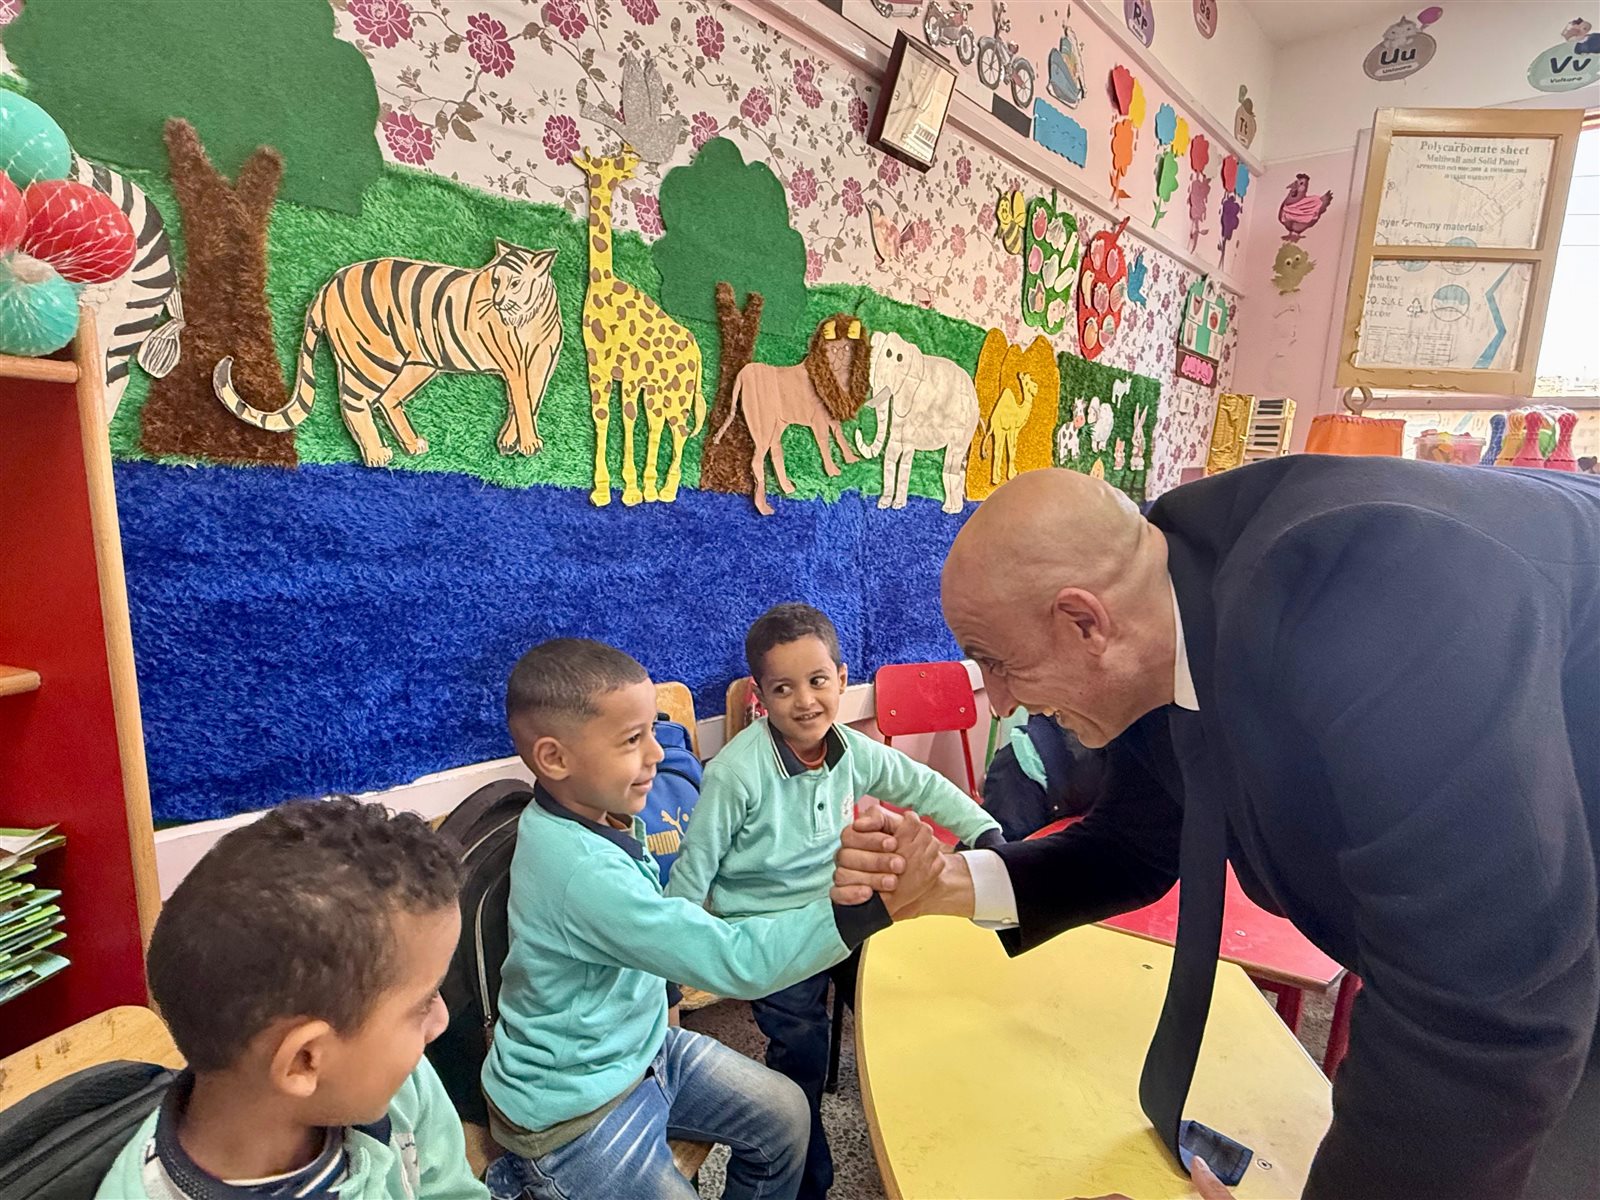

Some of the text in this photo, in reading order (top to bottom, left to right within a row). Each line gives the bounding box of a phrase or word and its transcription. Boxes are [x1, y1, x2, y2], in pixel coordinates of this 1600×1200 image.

[1380, 48, 1417, 66] Uu
[1550, 55, 1592, 74] Vv
[1420, 140, 1530, 155] Polycarbonate sheet
[1479, 156, 1497, 165] Solid
[1443, 222, 1485, 233] materials
